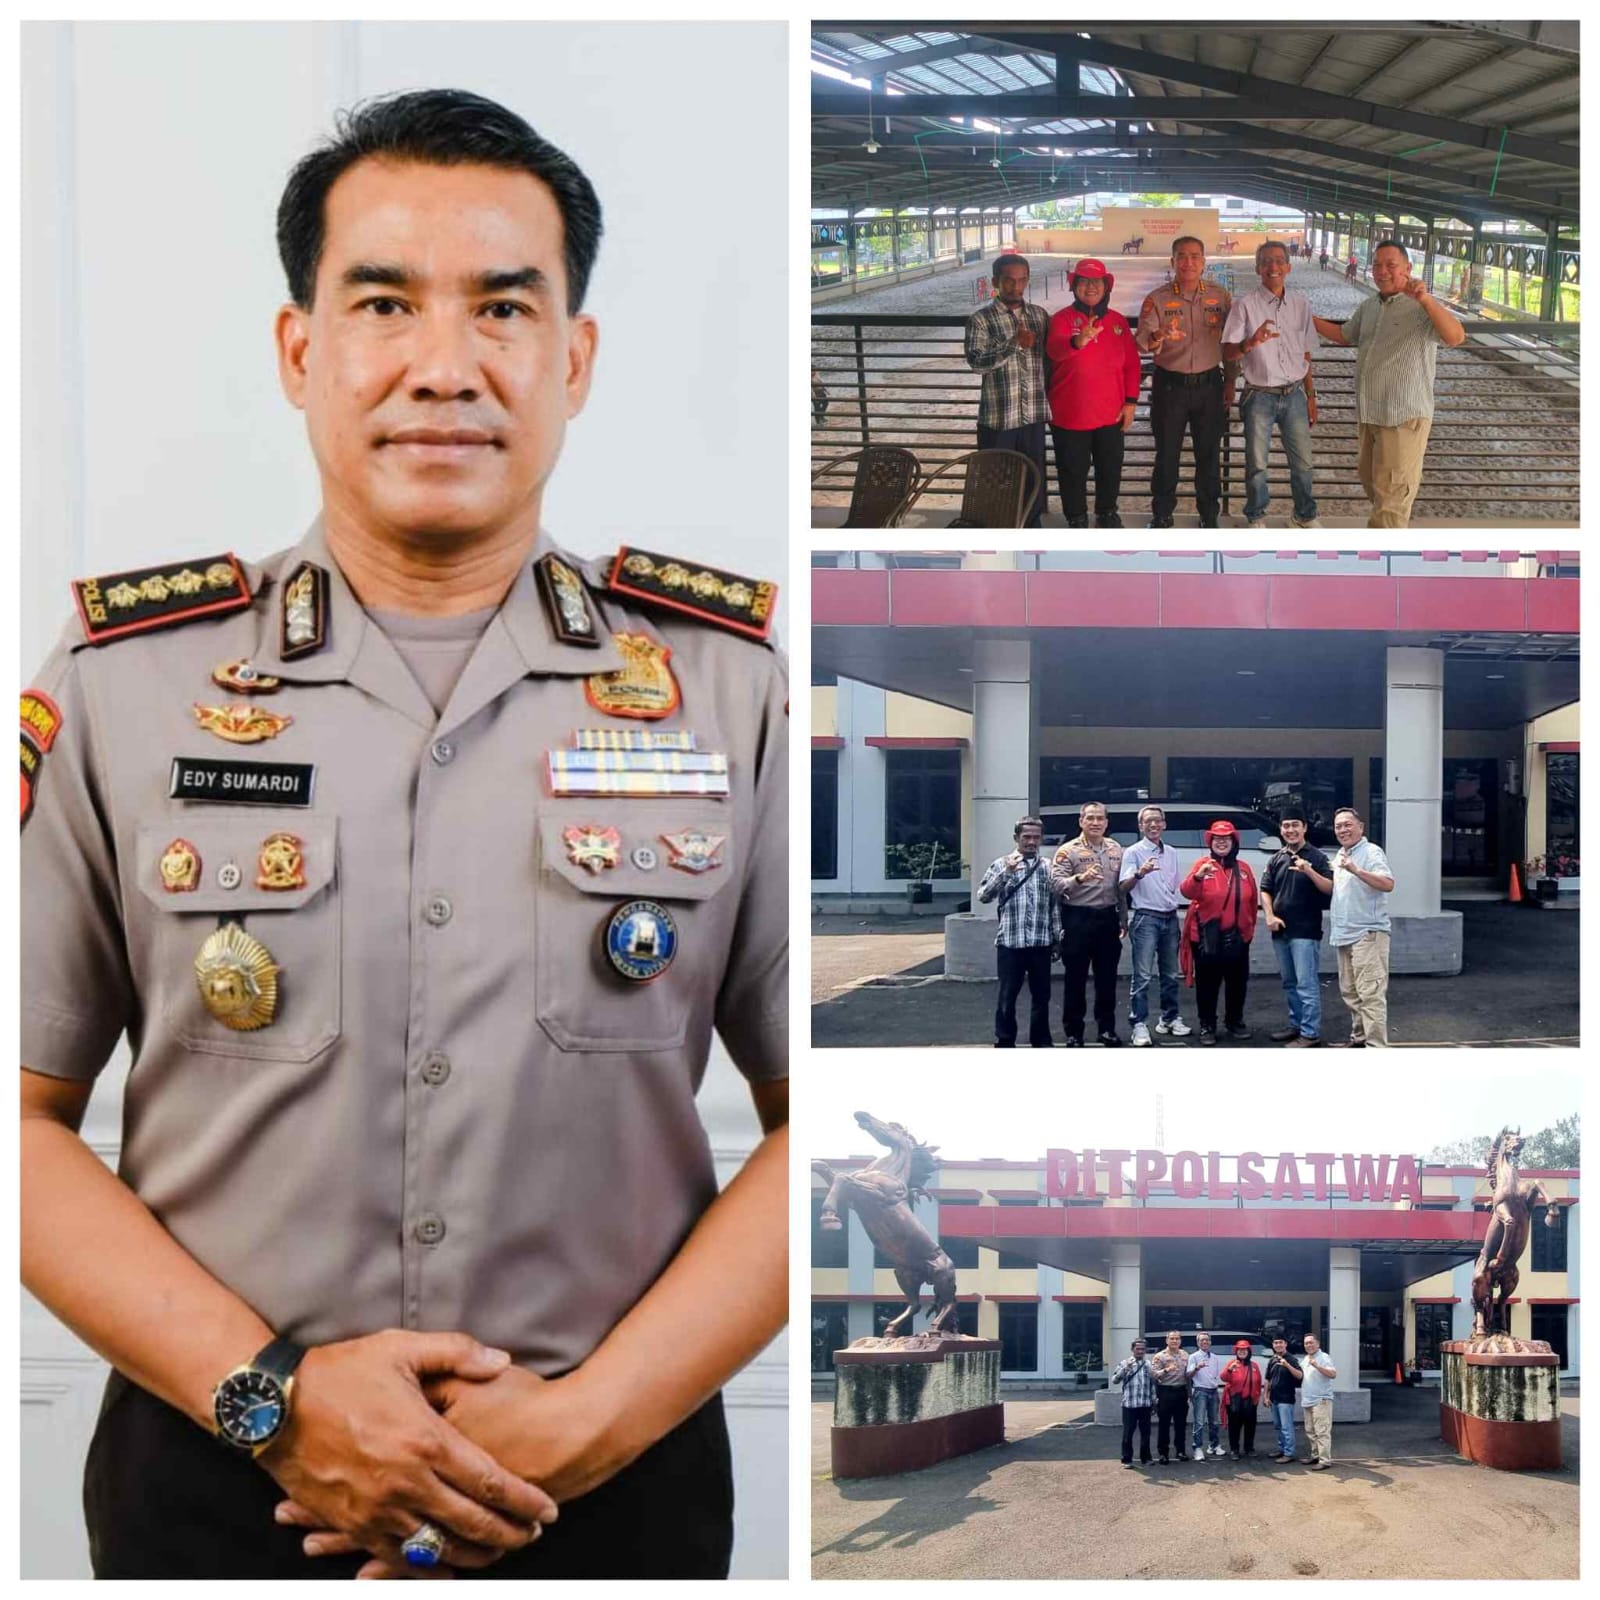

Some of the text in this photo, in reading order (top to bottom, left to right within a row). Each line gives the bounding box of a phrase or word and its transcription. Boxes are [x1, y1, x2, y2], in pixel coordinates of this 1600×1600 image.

[182, 770, 300, 793] EDY SUMARDI
[1046, 1147, 1422, 1203] DITPOLSATWA
